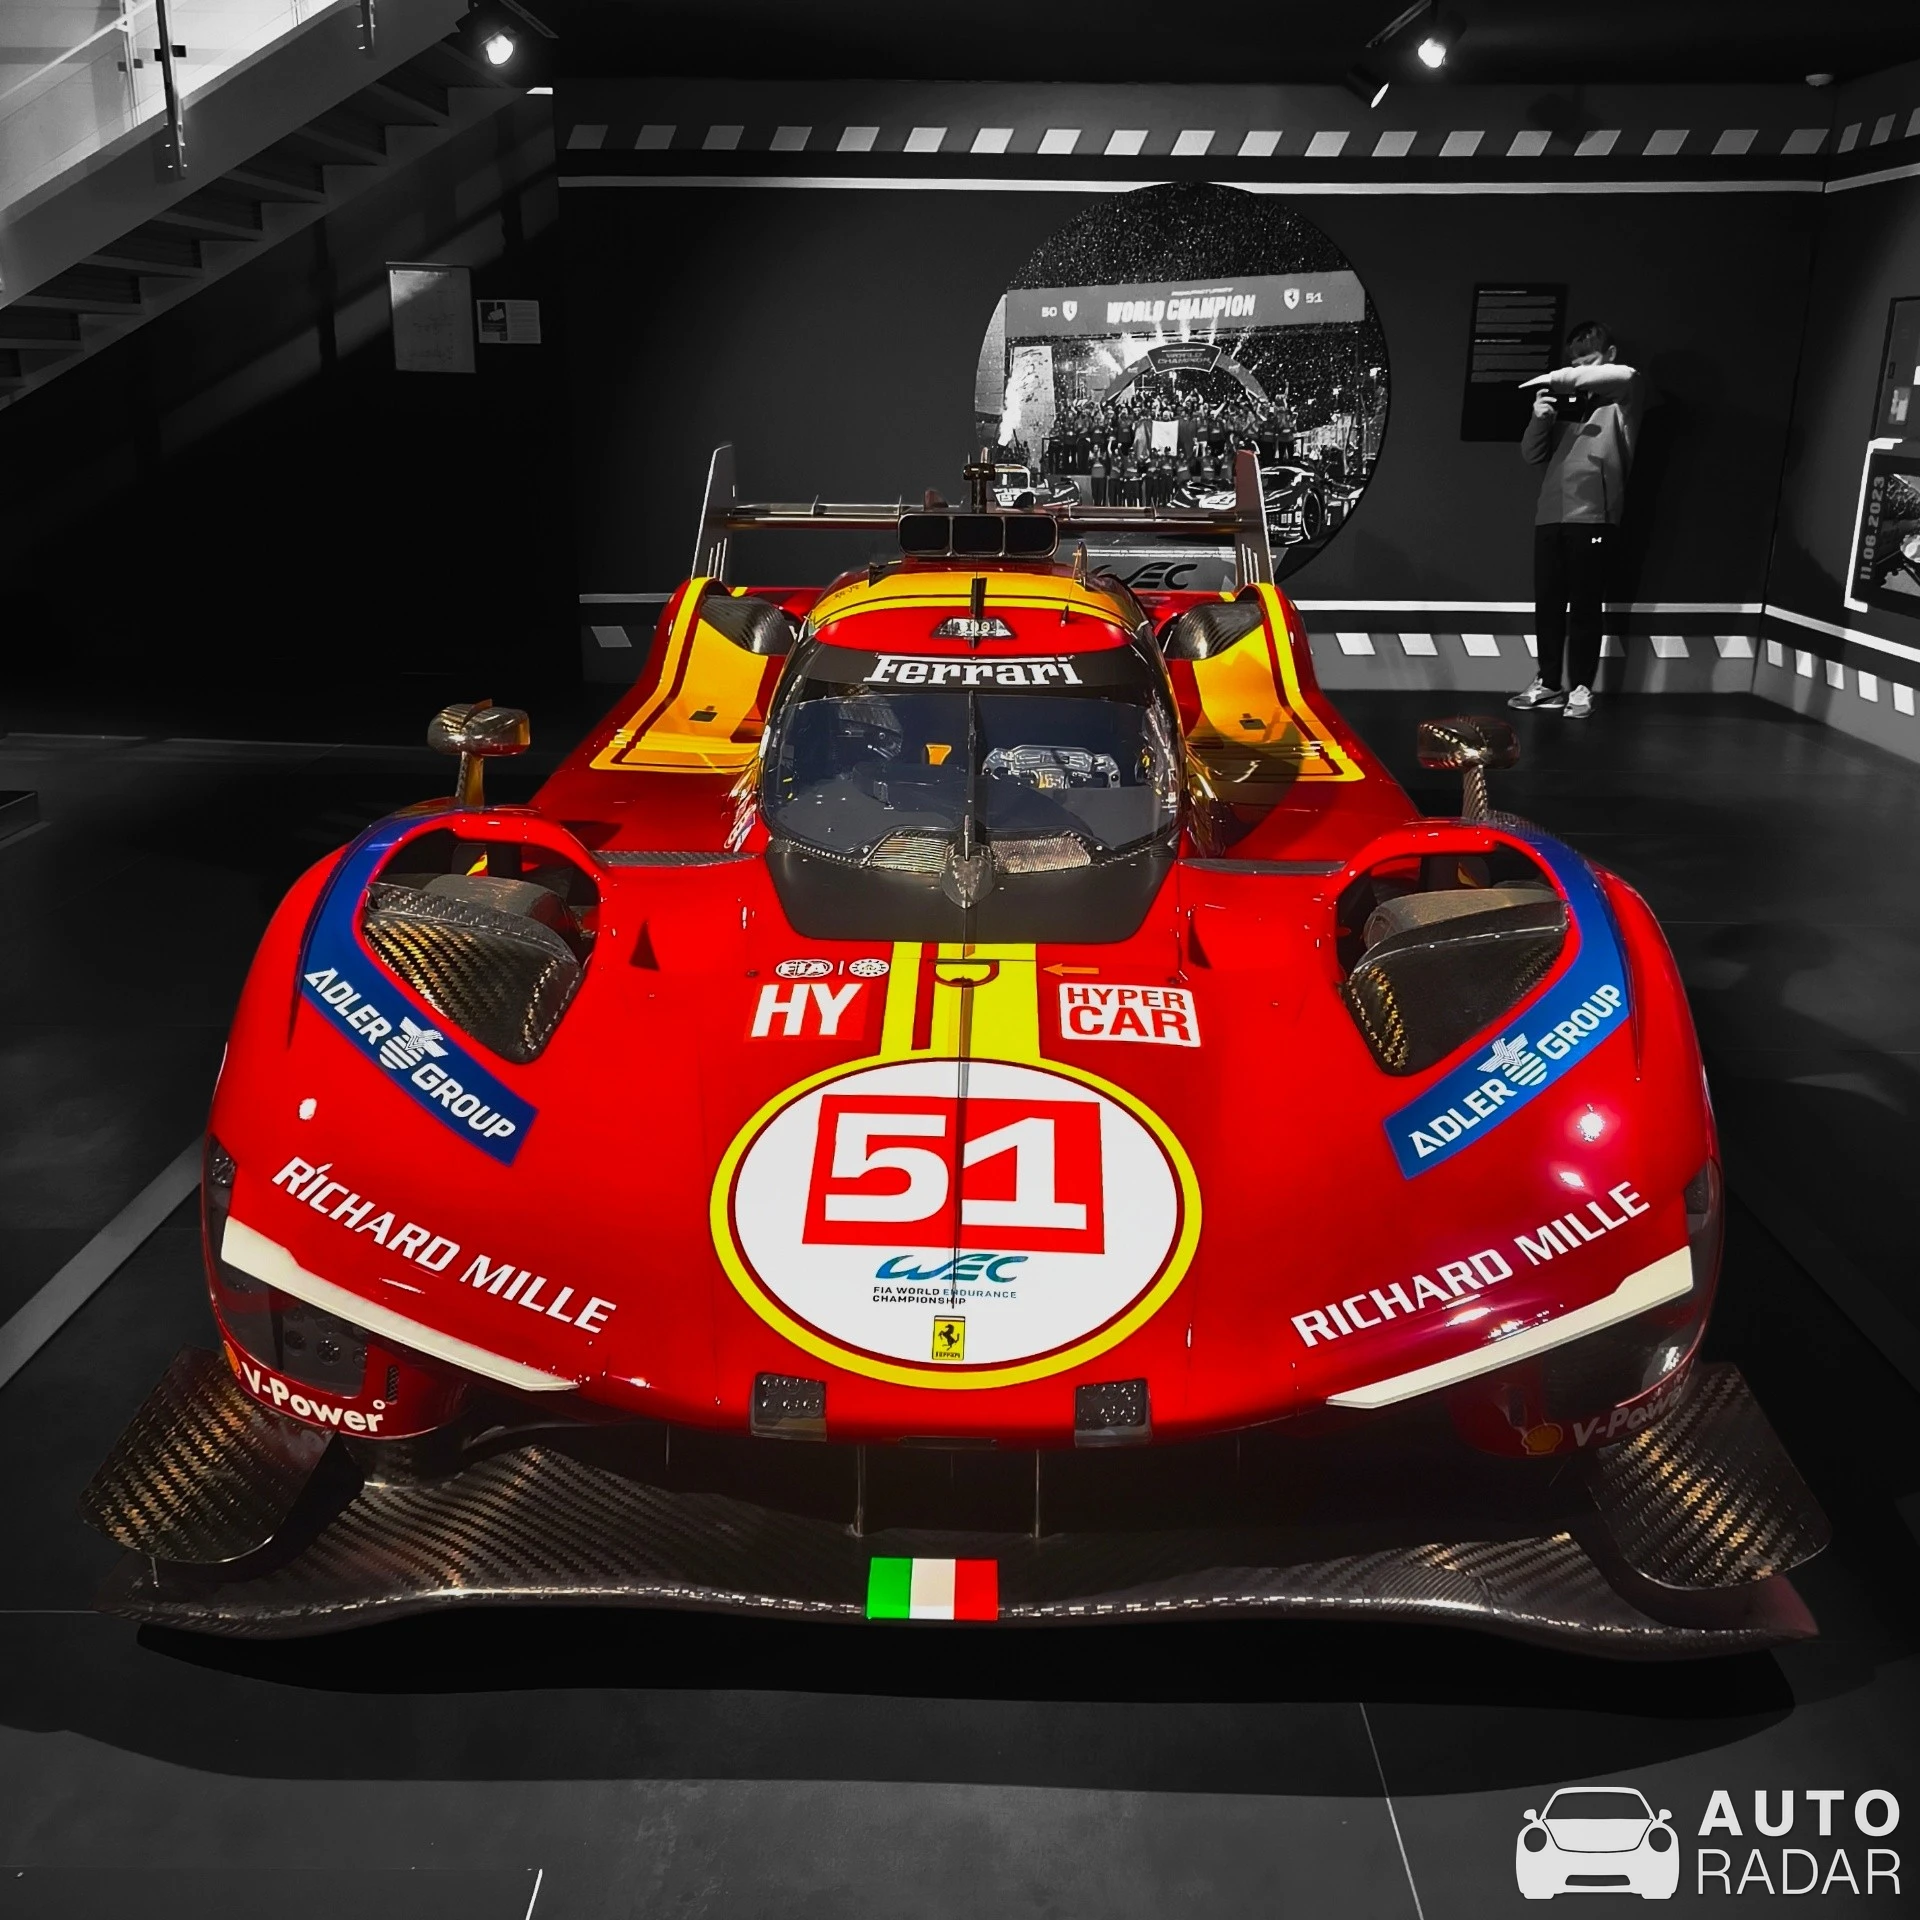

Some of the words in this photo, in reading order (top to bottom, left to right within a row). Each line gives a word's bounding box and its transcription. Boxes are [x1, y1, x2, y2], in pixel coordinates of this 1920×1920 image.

[1106, 300, 1166, 323] WORLD
[1166, 295, 1256, 321] CHAMPION
[1305, 292, 1323, 304] 51
[1860, 476, 1885, 580] 11.06.2023
[862, 652, 1083, 686] Ferrari
[750, 983, 863, 1038] HY
[1067, 987, 1187, 1011] HYPER
[1069, 1005, 1192, 1042] CAR
[304, 967, 393, 1046] ADLER
[411, 1062, 516, 1138] GROUP
[1408, 1078, 1518, 1158] ADLER
[1536, 984, 1622, 1060] GROUP
[825, 1112, 1087, 1230] 51
[271, 1156, 461, 1272] RICHARD
[459, 1254, 617, 1334] MILLE
[875, 1253, 1029, 1283] WEC
[1290, 1248, 1513, 1348] RICHARD
[1513, 1181, 1651, 1266] MILLE
[872, 1295, 966, 1305] CHAMPIONSHIP
[873, 1286, 893, 1295] FIA
[896, 1287, 940, 1296] WORLD
[943, 1288, 1017, 1299] ENDURANCE
[240, 1361, 384, 1432] V-Power
